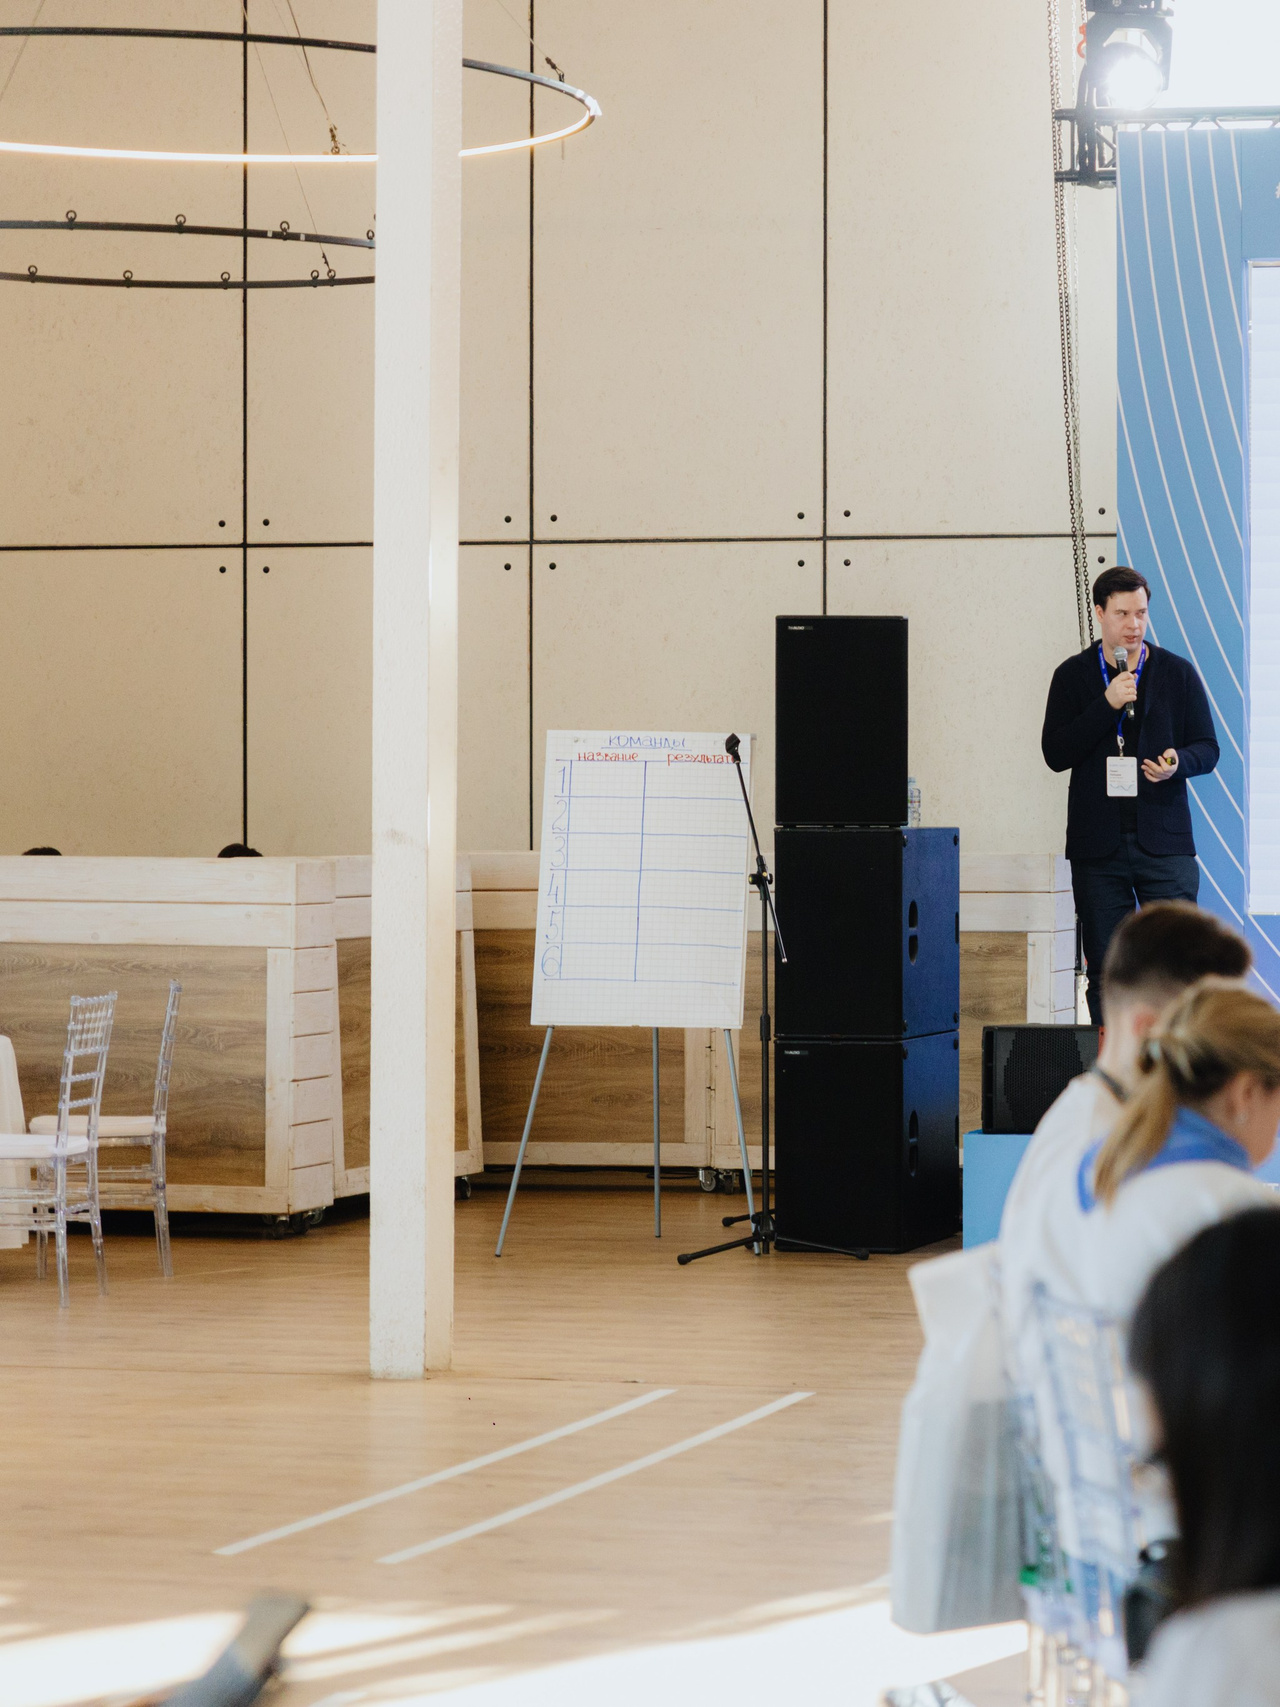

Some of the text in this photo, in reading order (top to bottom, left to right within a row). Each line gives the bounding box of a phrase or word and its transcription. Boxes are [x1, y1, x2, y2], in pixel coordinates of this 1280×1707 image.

[667, 753, 735, 766] результат
[552, 800, 567, 831] 2
[551, 836, 566, 868] 3
[547, 873, 559, 904] 4
[541, 945, 560, 978] 6
